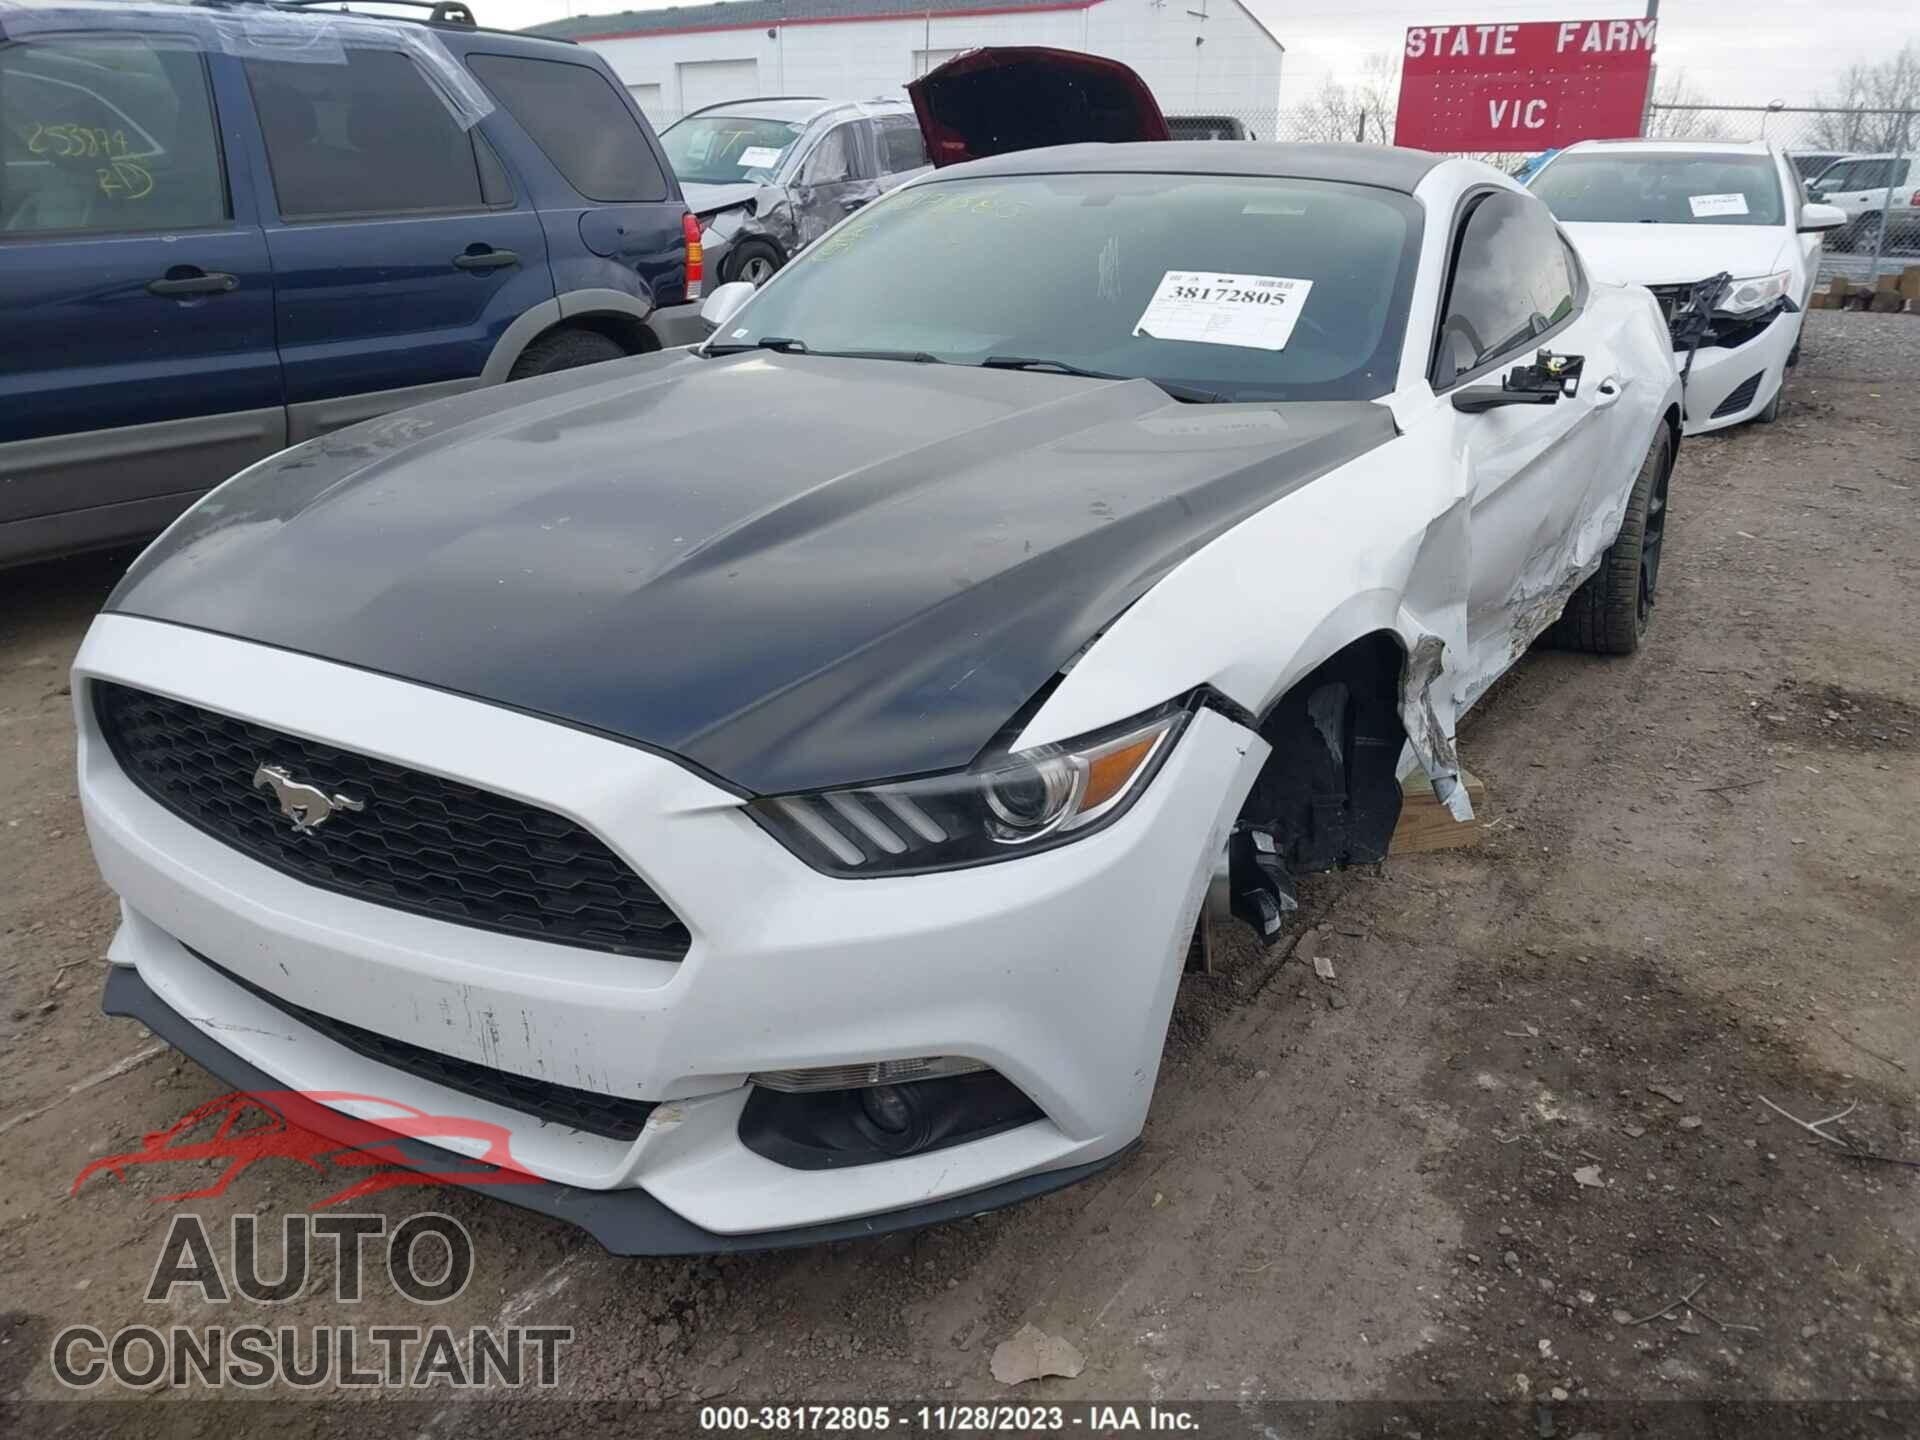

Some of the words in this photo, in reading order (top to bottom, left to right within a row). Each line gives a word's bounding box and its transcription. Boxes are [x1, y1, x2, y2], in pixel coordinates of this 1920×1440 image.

[1406, 25, 1519, 57] STATE
[1556, 20, 1656, 53] FARM
[1488, 99, 1548, 129] VIC
[1168, 286, 1287, 306] 38172805
